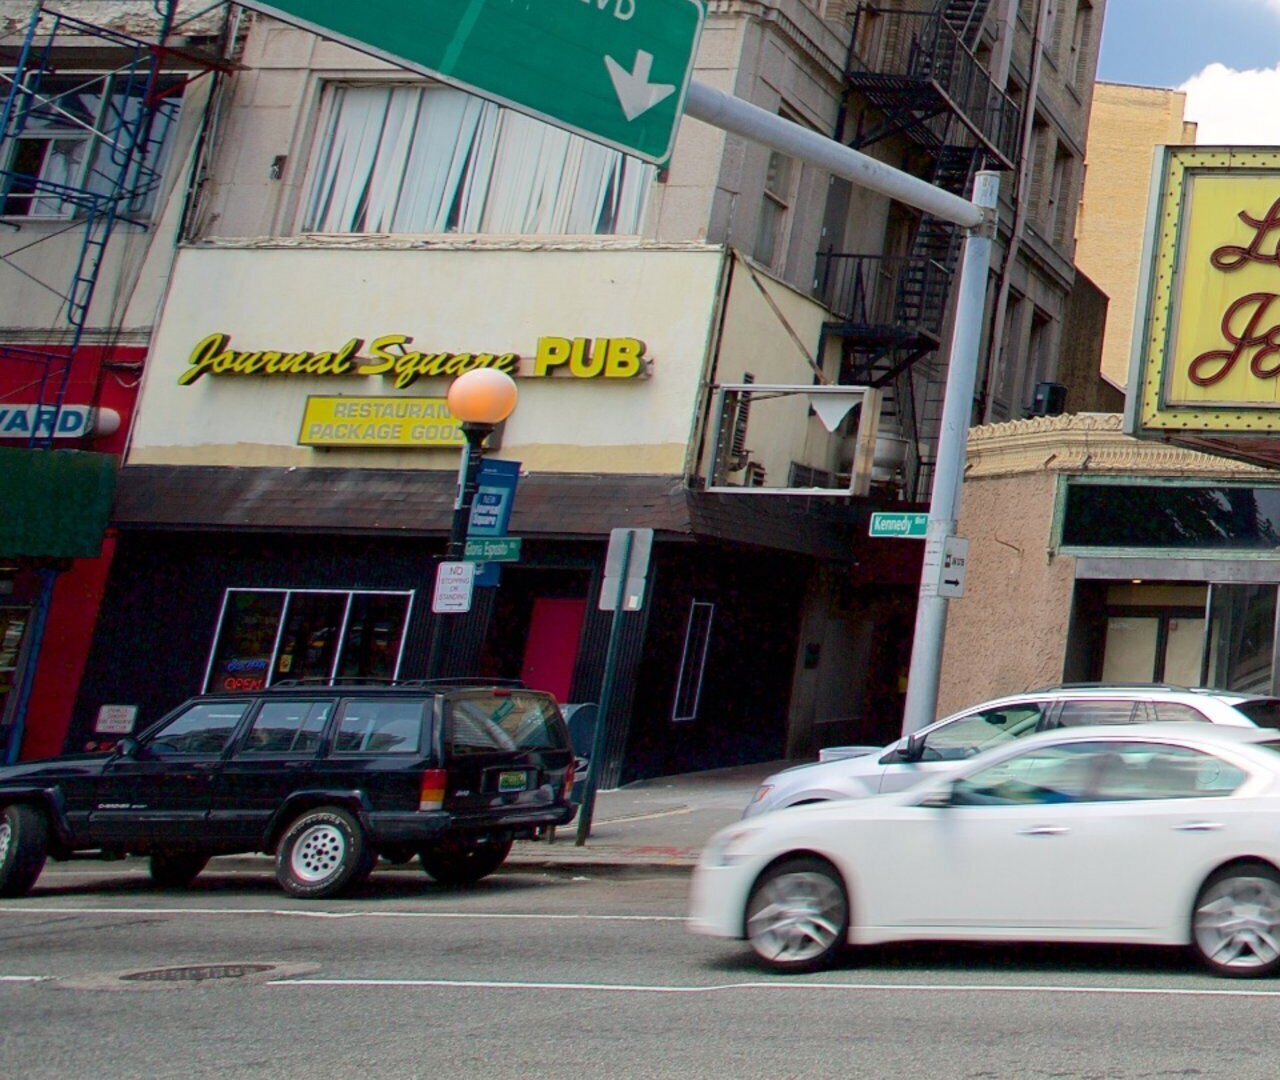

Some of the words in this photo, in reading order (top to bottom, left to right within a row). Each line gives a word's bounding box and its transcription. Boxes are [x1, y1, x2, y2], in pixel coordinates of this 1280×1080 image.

[178, 332, 361, 385] Journal
[359, 334, 516, 388] Square
[535, 336, 643, 379] PUB
[333, 402, 450, 418] RESTAURAN
[309, 423, 402, 440] PACKAGE
[874, 516, 912, 535] Kennedy
[449, 566, 463, 576] NO
